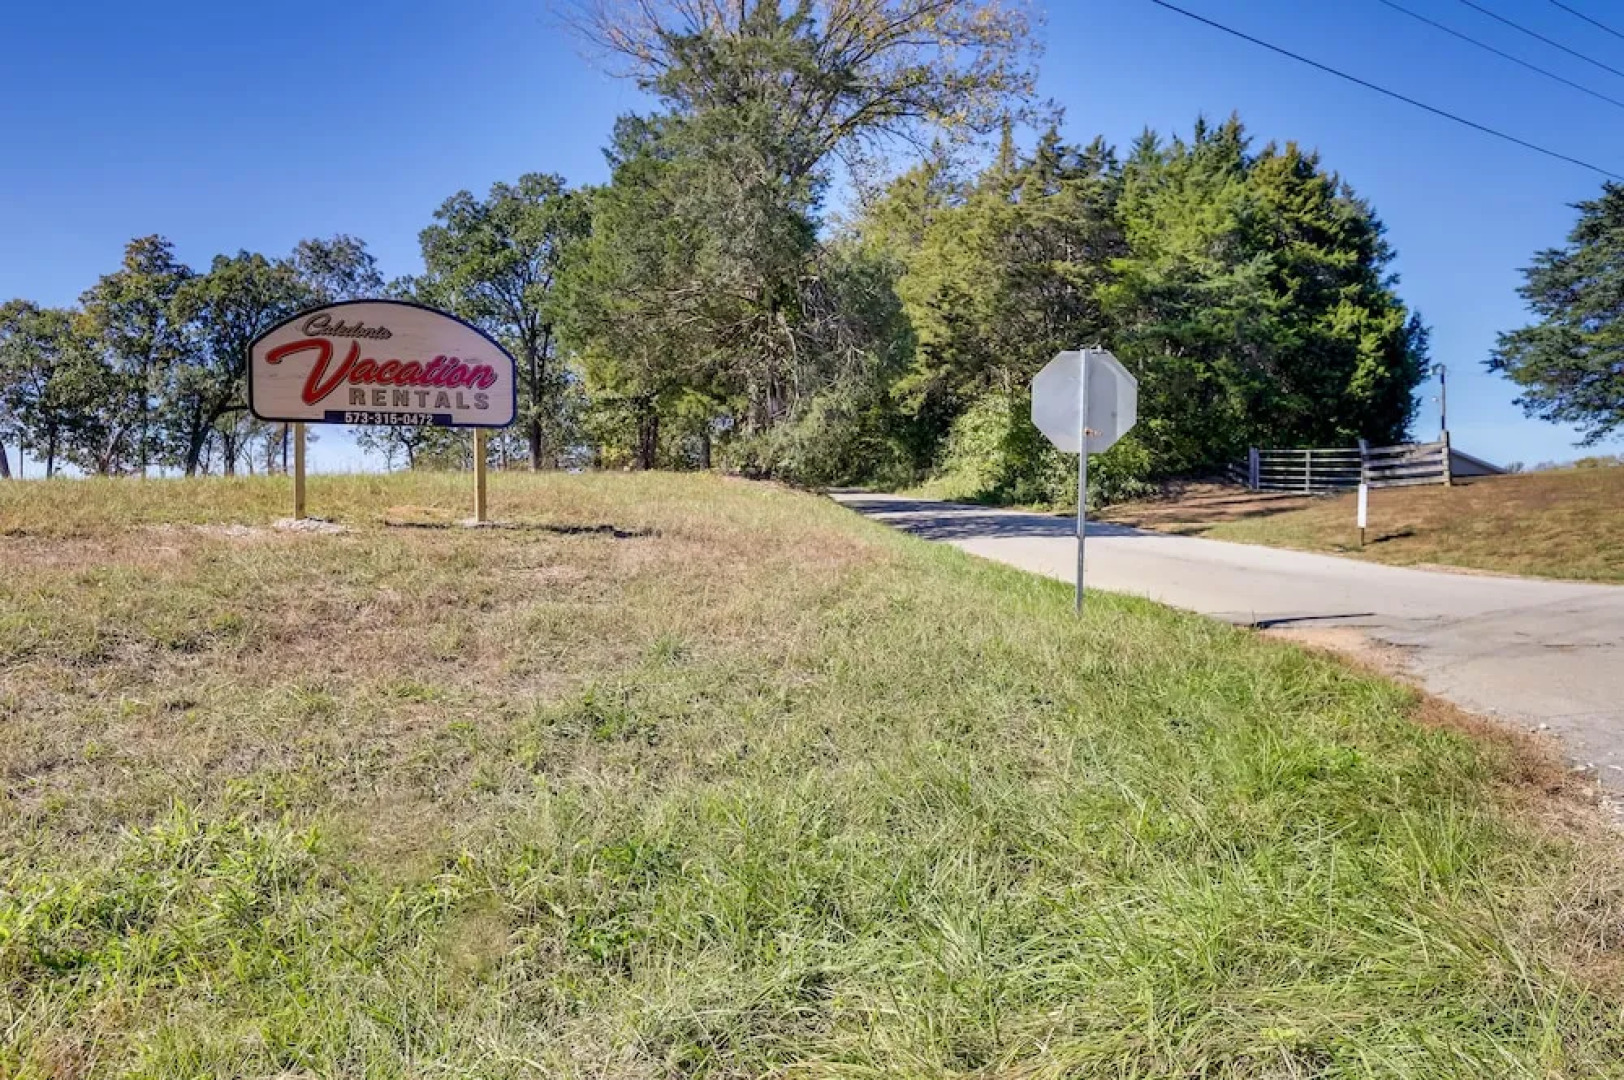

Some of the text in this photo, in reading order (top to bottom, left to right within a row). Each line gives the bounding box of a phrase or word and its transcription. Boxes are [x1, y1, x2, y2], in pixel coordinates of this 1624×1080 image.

[265, 338, 498, 406] Vacation
[348, 387, 489, 410] RENTALS
[345, 412, 433, 425] 573-315-0472
